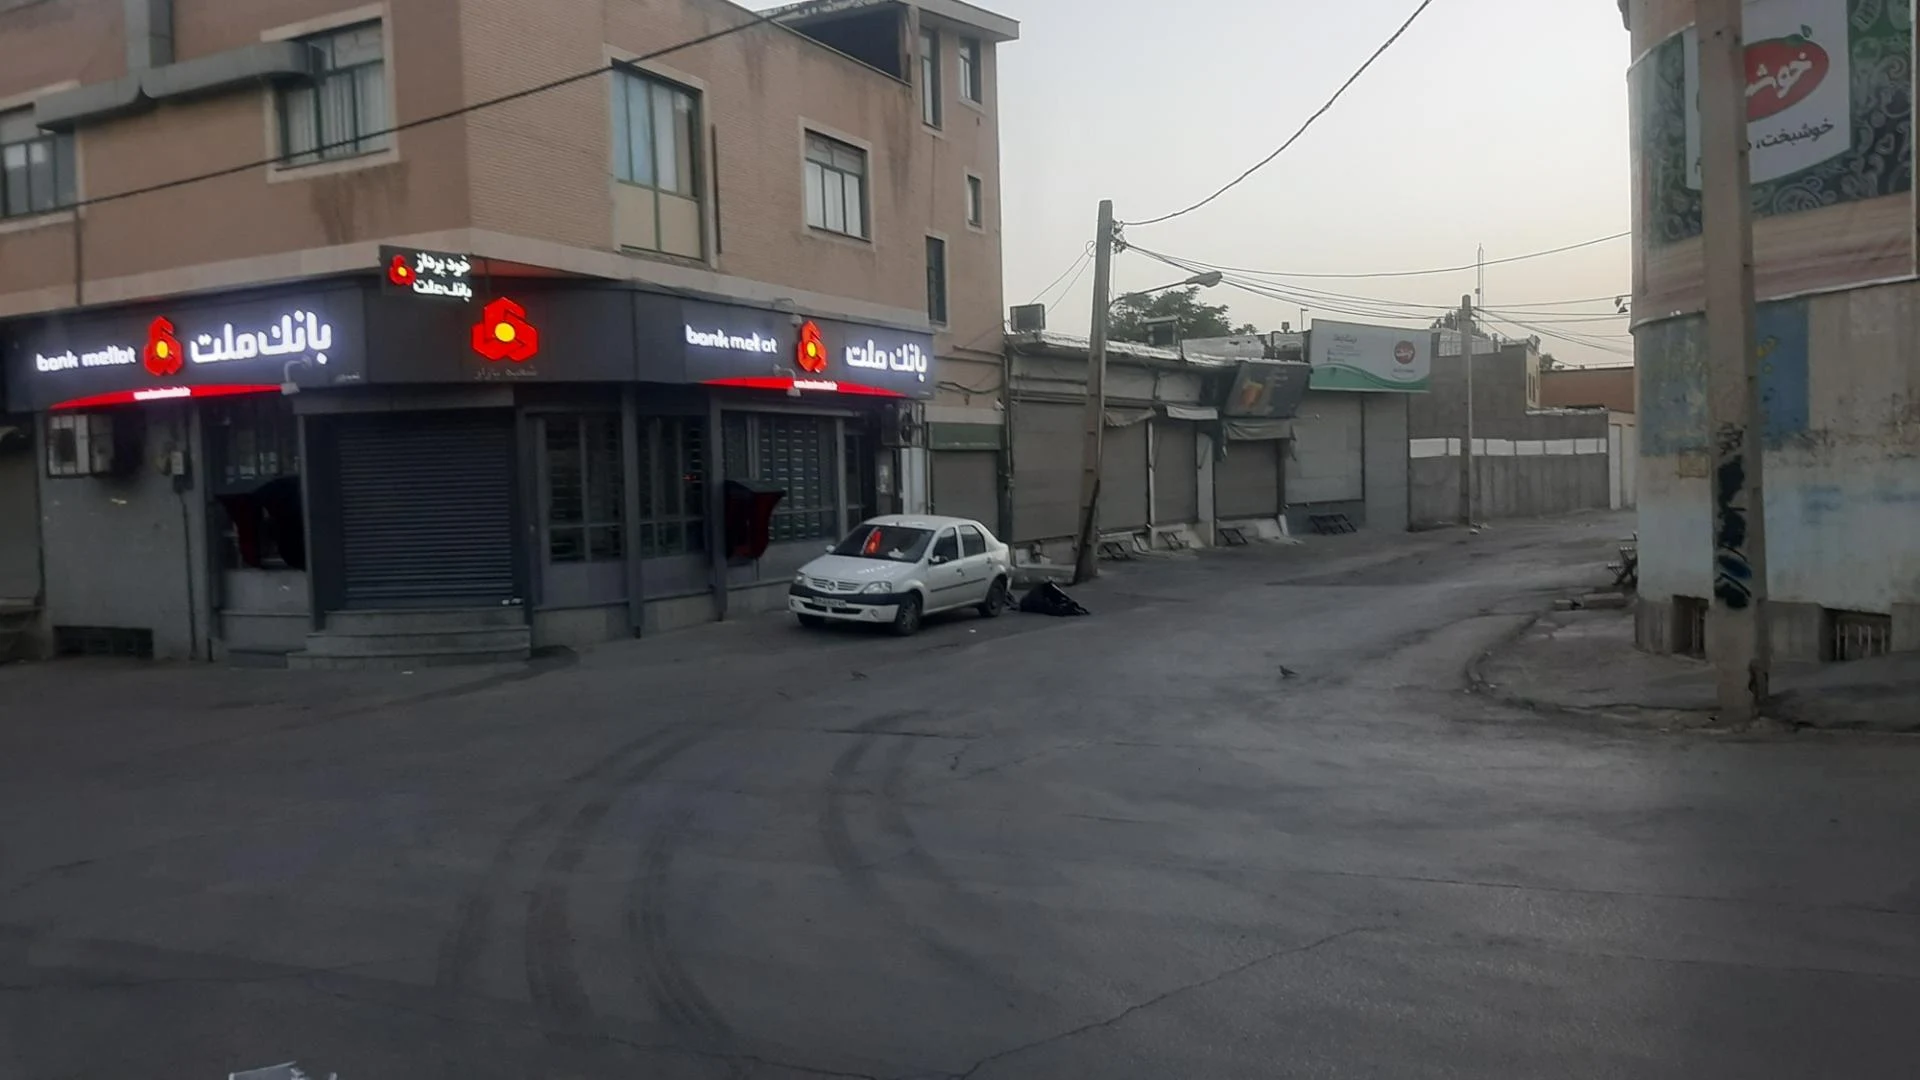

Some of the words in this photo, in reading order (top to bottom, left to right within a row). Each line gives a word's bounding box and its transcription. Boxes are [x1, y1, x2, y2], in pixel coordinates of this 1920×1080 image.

[191, 322, 259, 363] ملت
[685, 324, 730, 349] bank
[730, 332, 778, 354] melat
[36, 353, 79, 371] bank
[82, 345, 136, 367] mellat
[845, 339, 888, 370] ملت
